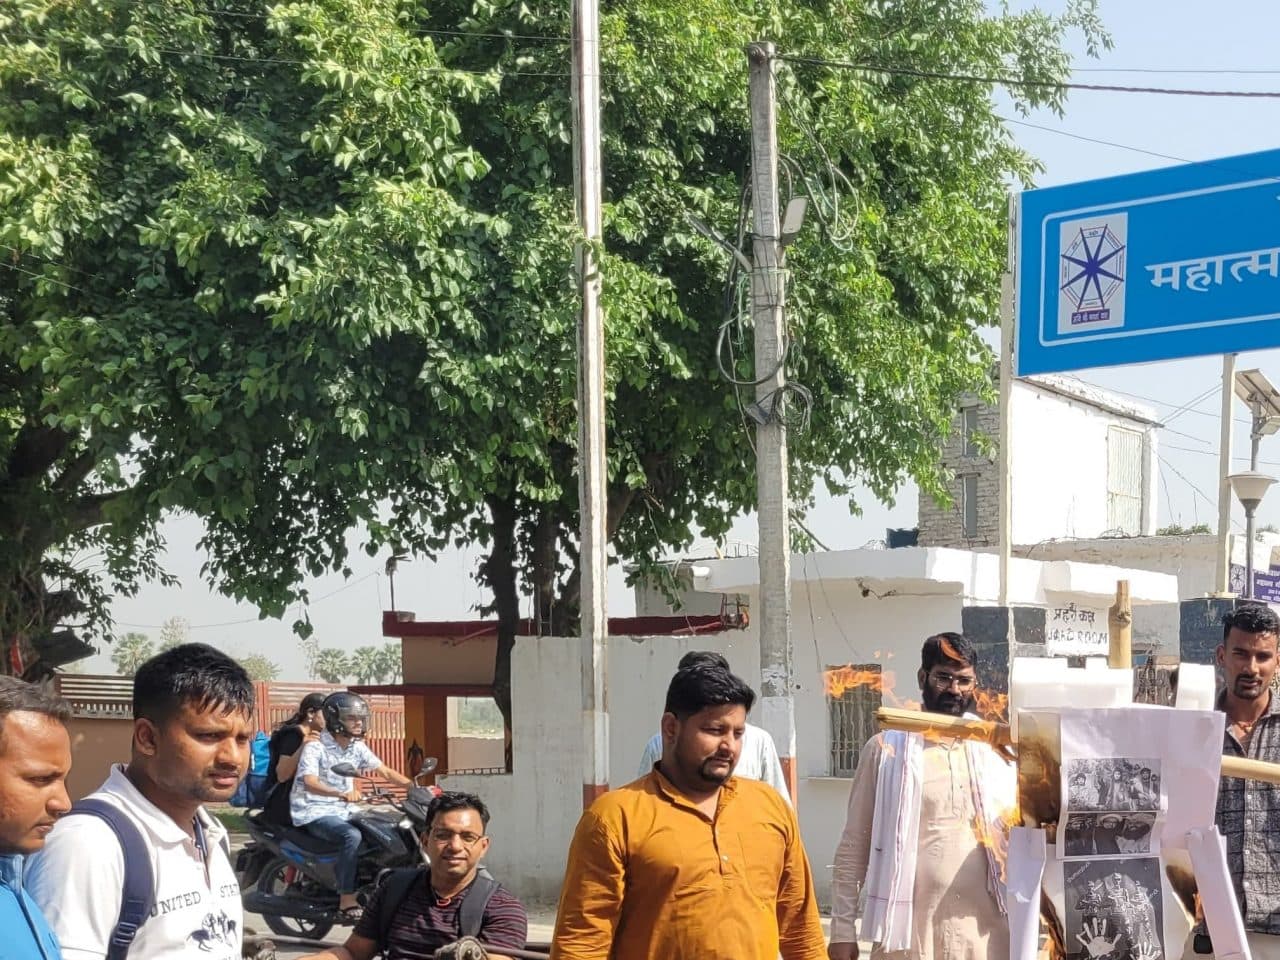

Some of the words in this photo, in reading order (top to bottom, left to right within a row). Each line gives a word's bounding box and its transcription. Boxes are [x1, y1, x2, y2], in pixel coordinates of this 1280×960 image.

[1077, 630, 1108, 645] ROOM
[150, 890, 202, 918] UNITED
[220, 883, 240, 898] STAT
